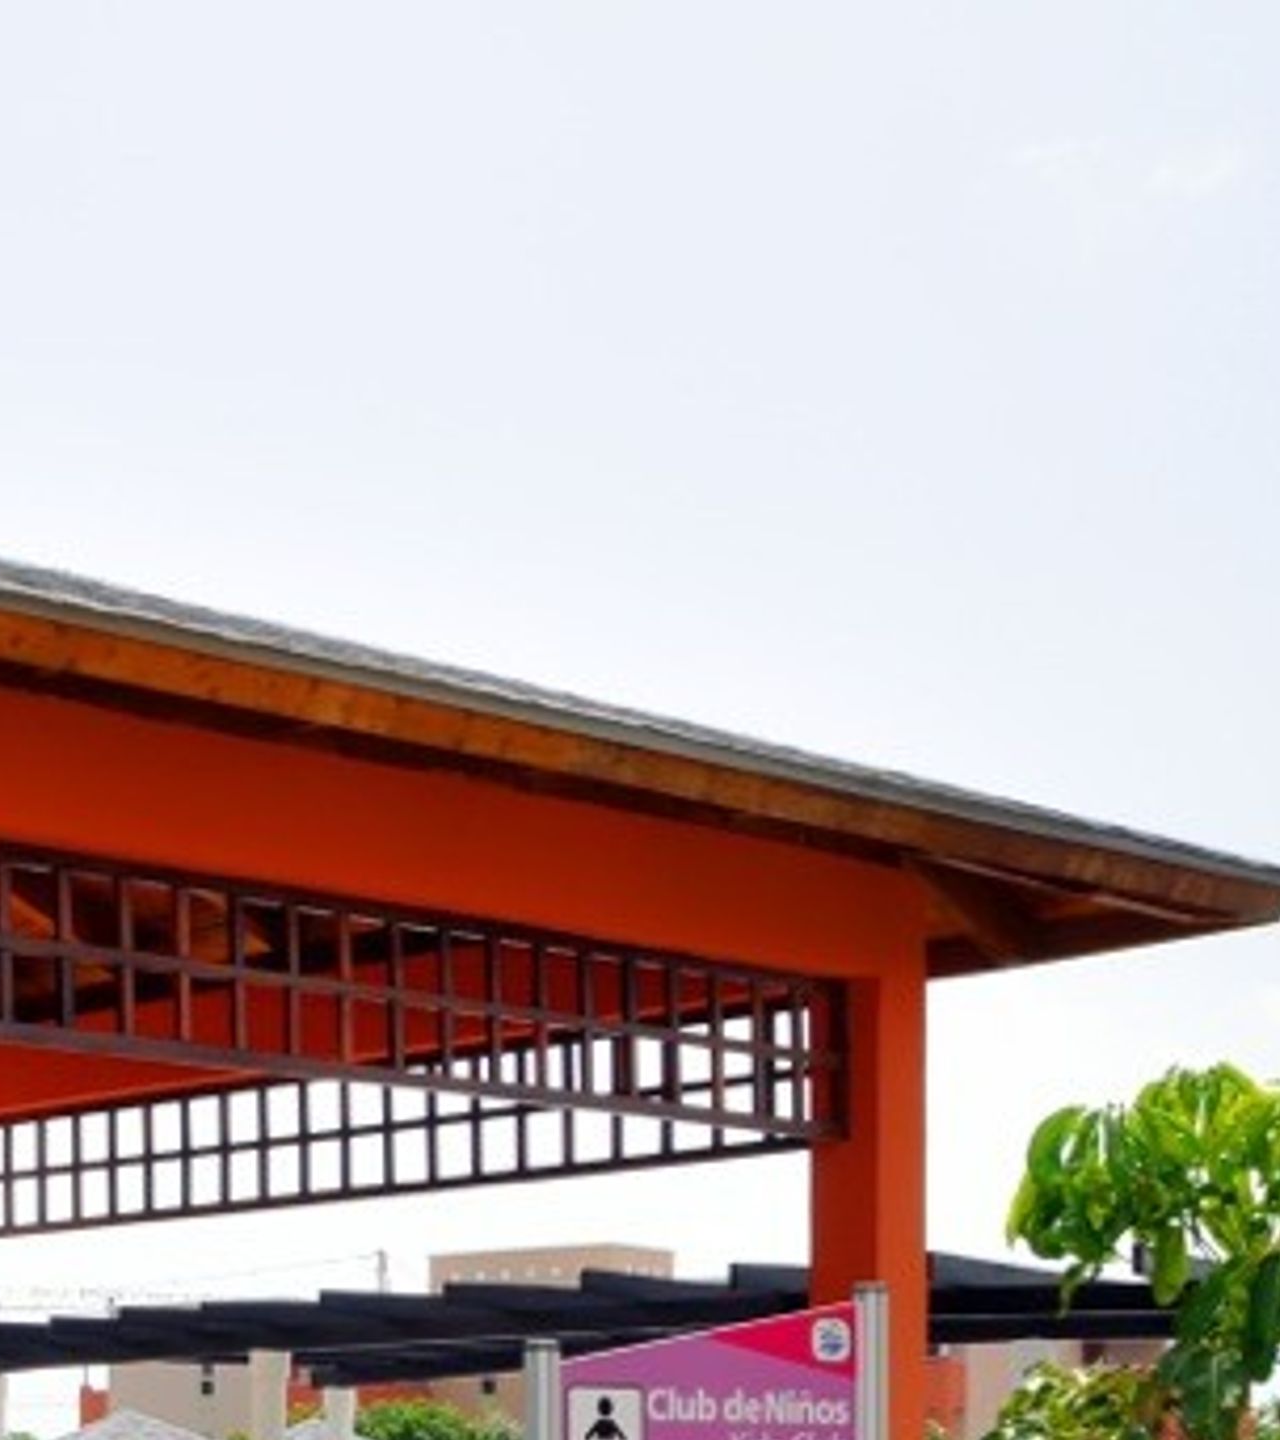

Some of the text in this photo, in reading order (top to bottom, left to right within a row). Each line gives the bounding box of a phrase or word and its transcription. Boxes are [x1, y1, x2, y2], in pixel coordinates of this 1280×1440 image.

[646, 1387, 851, 1426] Club de Niños
